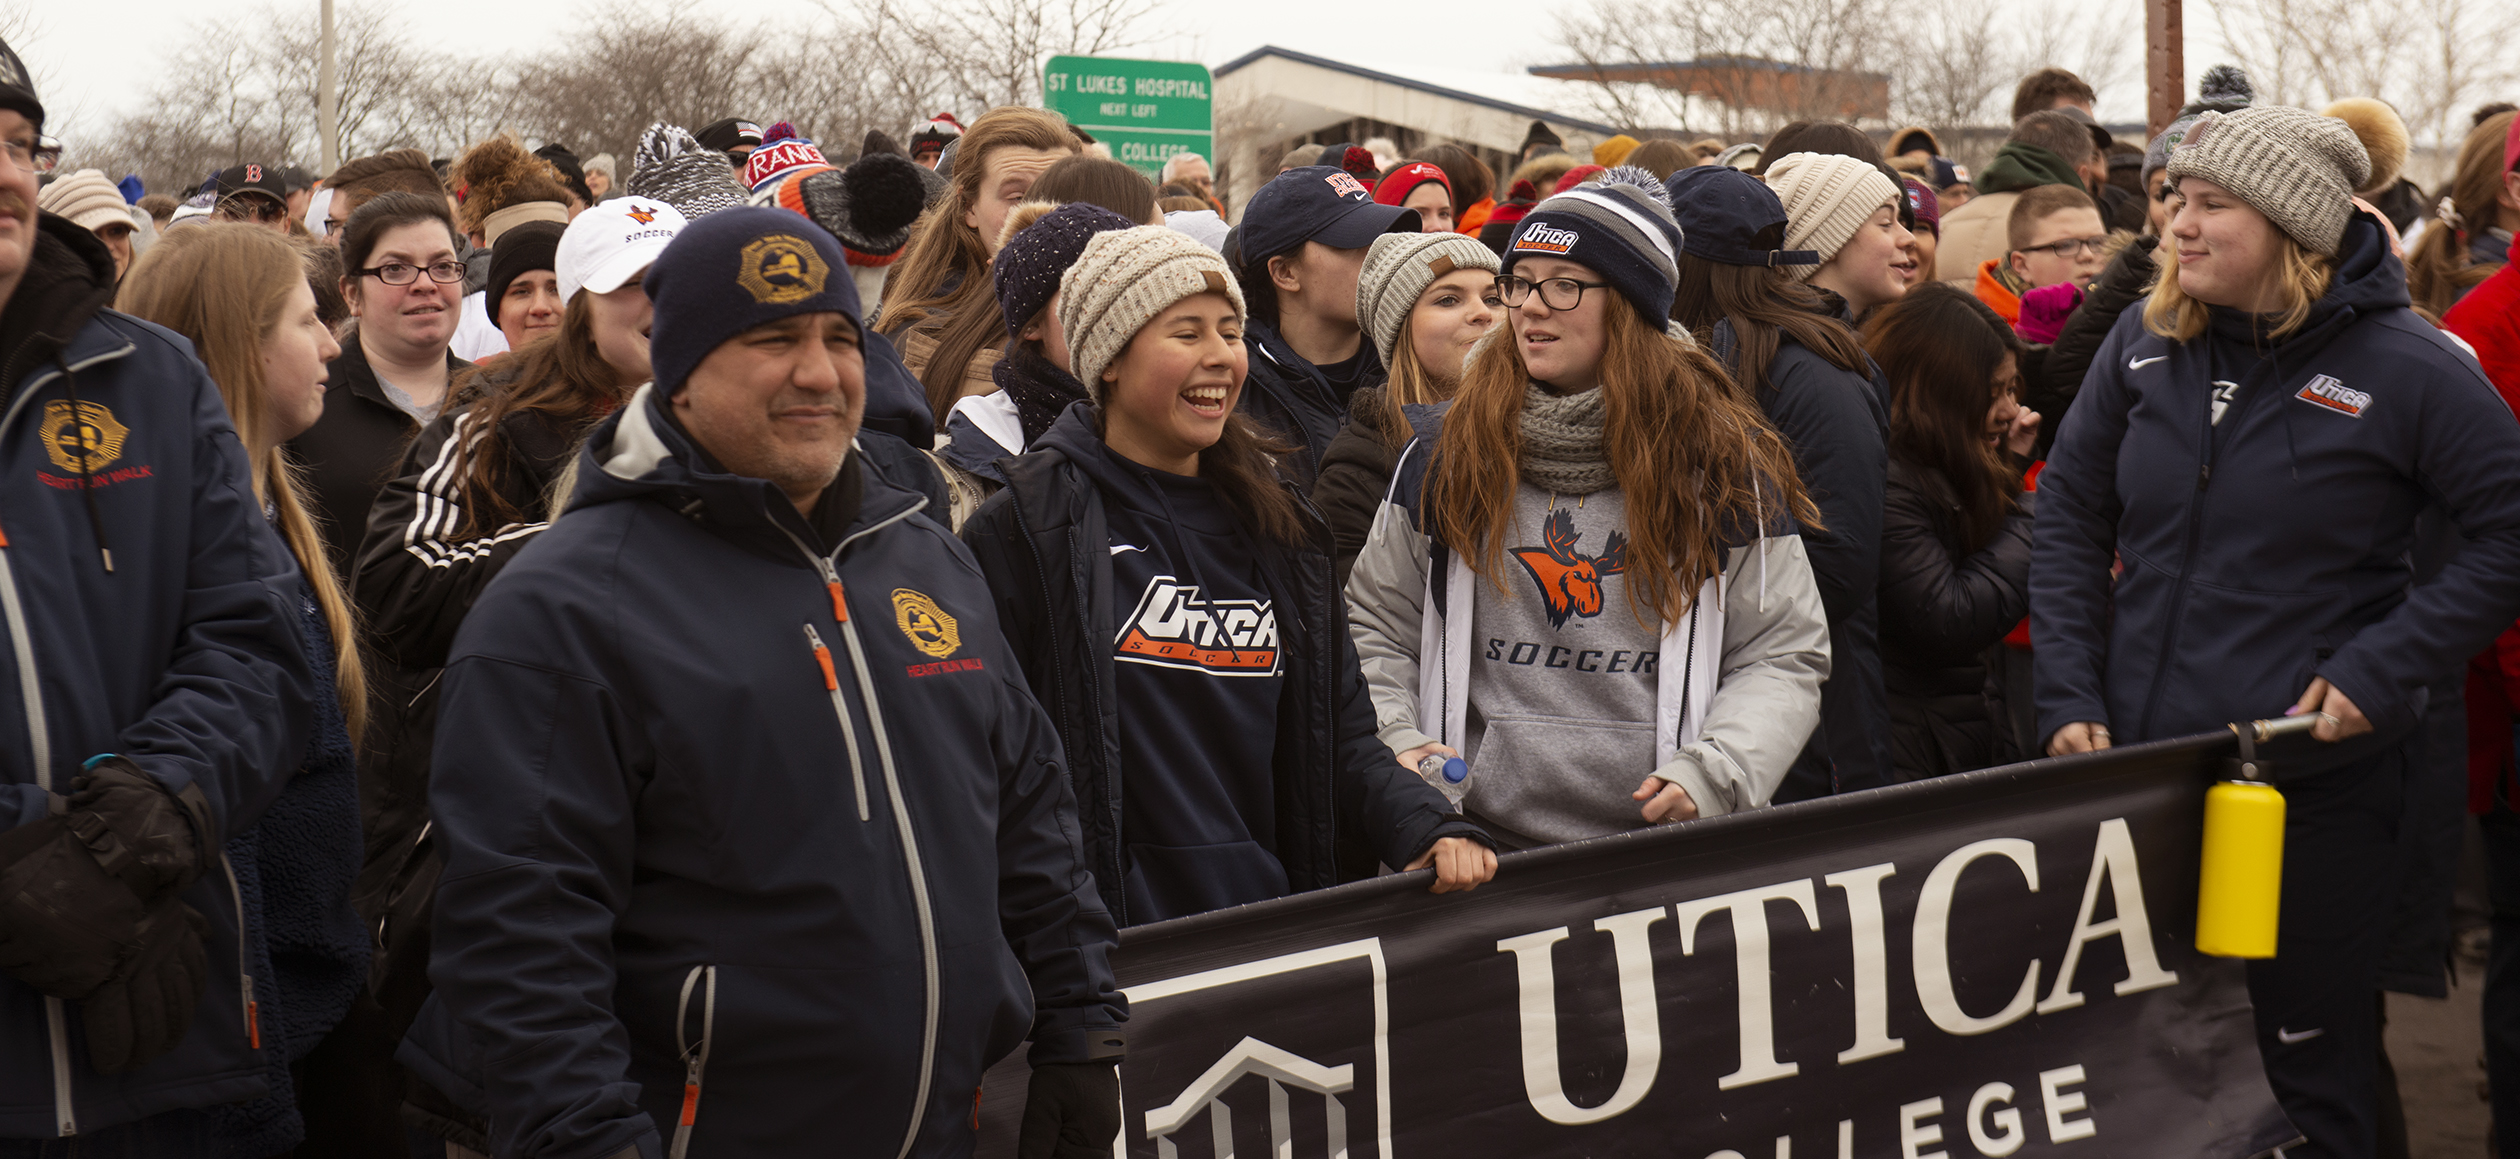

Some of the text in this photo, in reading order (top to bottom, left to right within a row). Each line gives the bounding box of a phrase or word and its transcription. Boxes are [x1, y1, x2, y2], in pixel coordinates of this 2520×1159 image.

[1048, 73, 1208, 100] ST LUKES HOSPITAL
[1100, 102, 1157, 118] NEXT LEFT
[244, 163, 262, 183] B
[626, 230, 675, 243] SOCCER
[1522, 223, 1577, 246] UTICA
[1521, 243, 1561, 251] SOCCER
[2309, 376, 2368, 408] UTICA
[1138, 584, 1277, 647] UTICA
[1485, 638, 1659, 673] SOCCER
[906, 662, 941, 678] HEART
[1496, 817, 2179, 1125] UTICA
